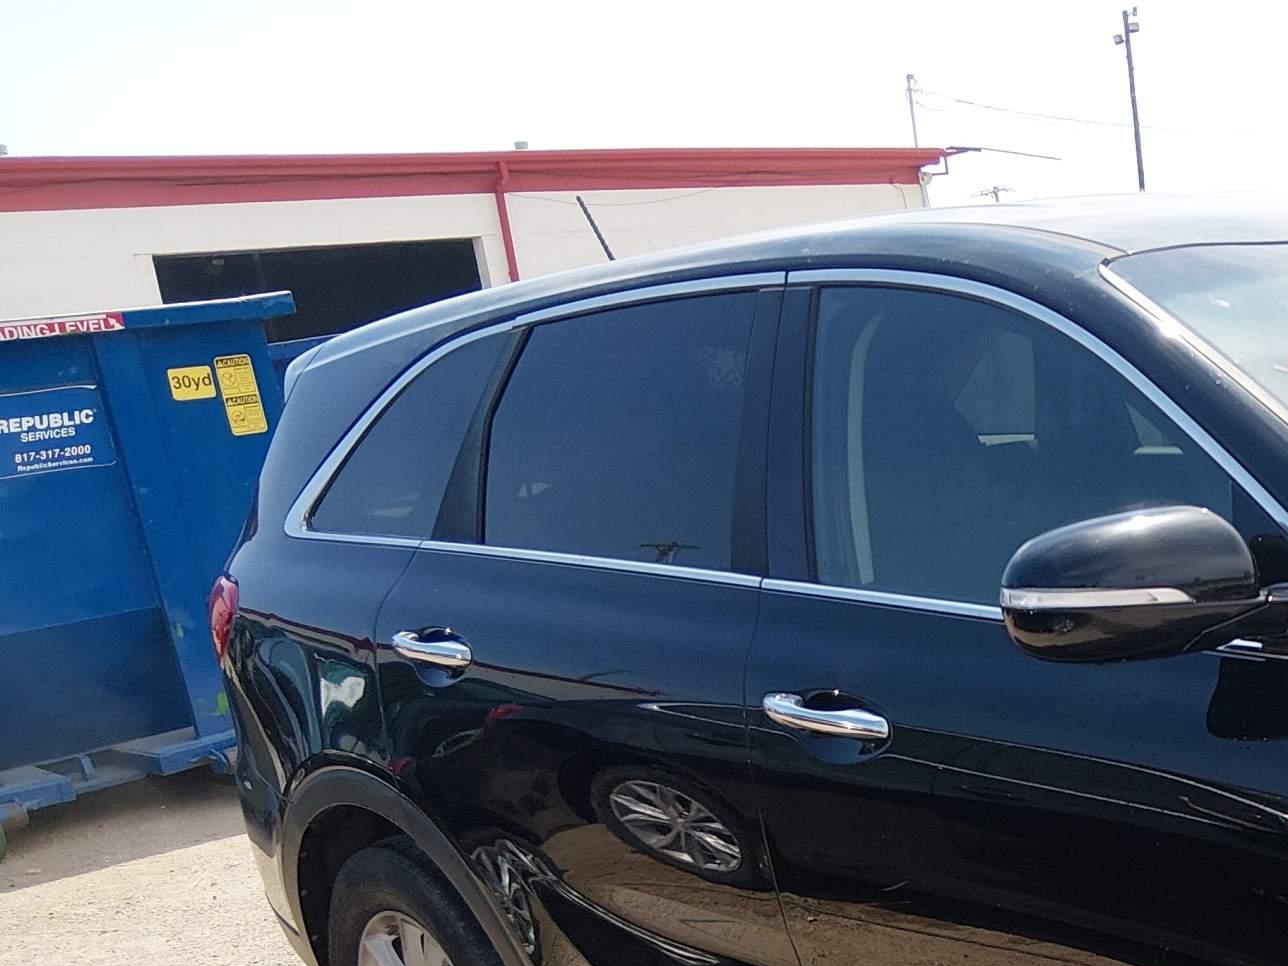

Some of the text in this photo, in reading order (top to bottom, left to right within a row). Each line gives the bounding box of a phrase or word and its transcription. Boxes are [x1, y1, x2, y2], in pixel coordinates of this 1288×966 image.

[54, 319, 111, 335] LEVEL
[223, 357, 250, 367] CAUTION
[171, 372, 212, 391] 30yd
[232, 395, 259, 405] CAUTION
[0, 408, 94, 435] REPUBLIC
[20, 426, 76, 443] SERVICES
[15, 444, 92, 463] 817-317-2000
